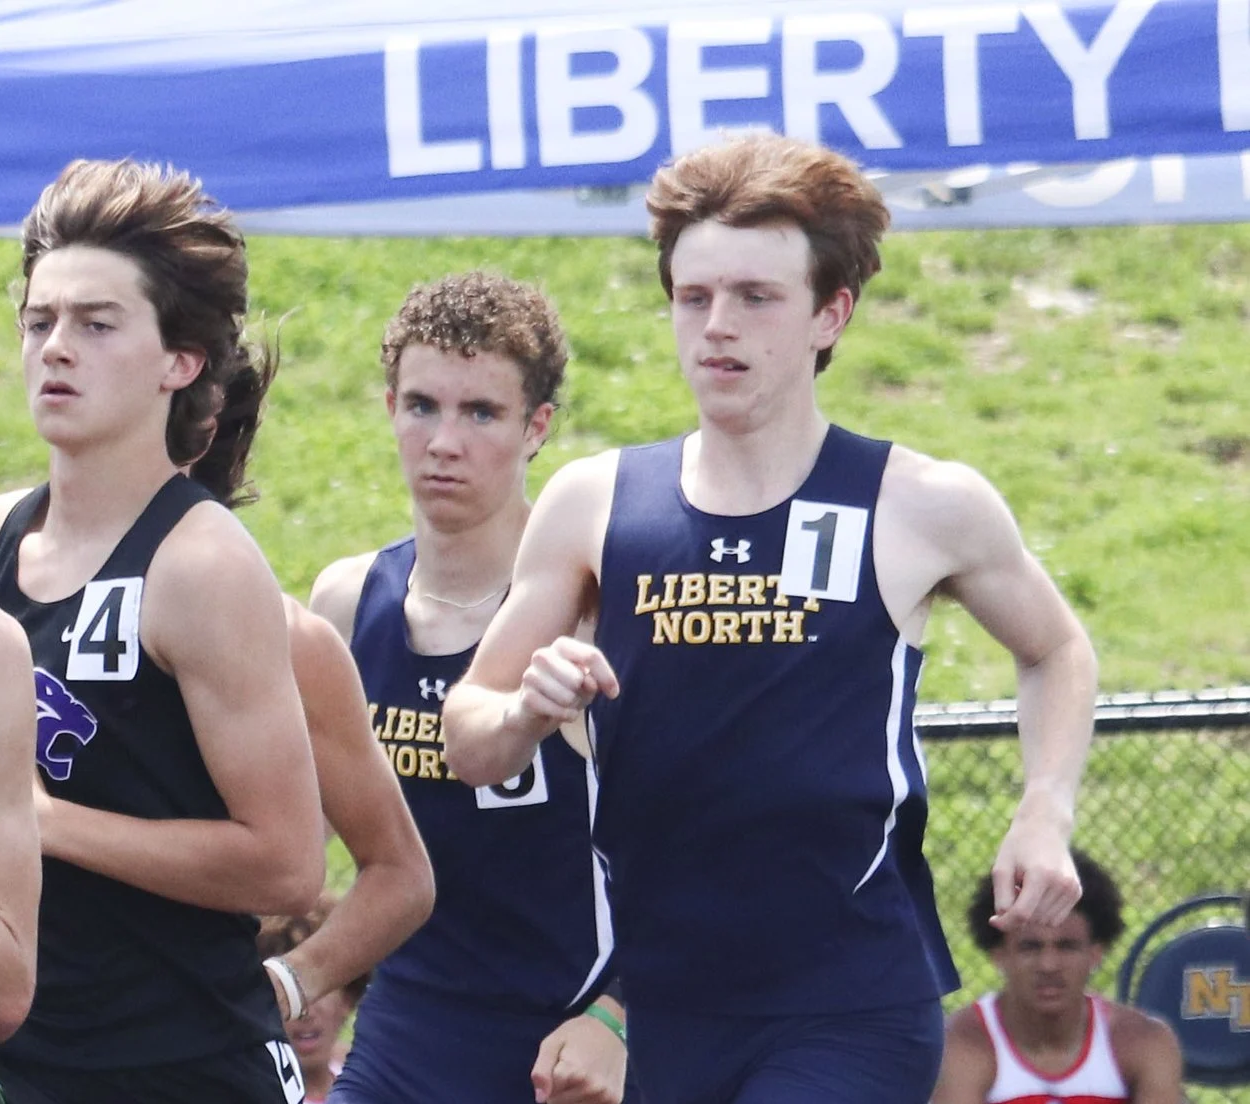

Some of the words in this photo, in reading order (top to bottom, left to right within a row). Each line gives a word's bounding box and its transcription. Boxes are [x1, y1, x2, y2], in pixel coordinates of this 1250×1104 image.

[384, 2, 1148, 178] LIBERTY
[801, 511, 838, 592] 1
[77, 586, 127, 672] 4
[652, 610, 804, 645] NORTH
